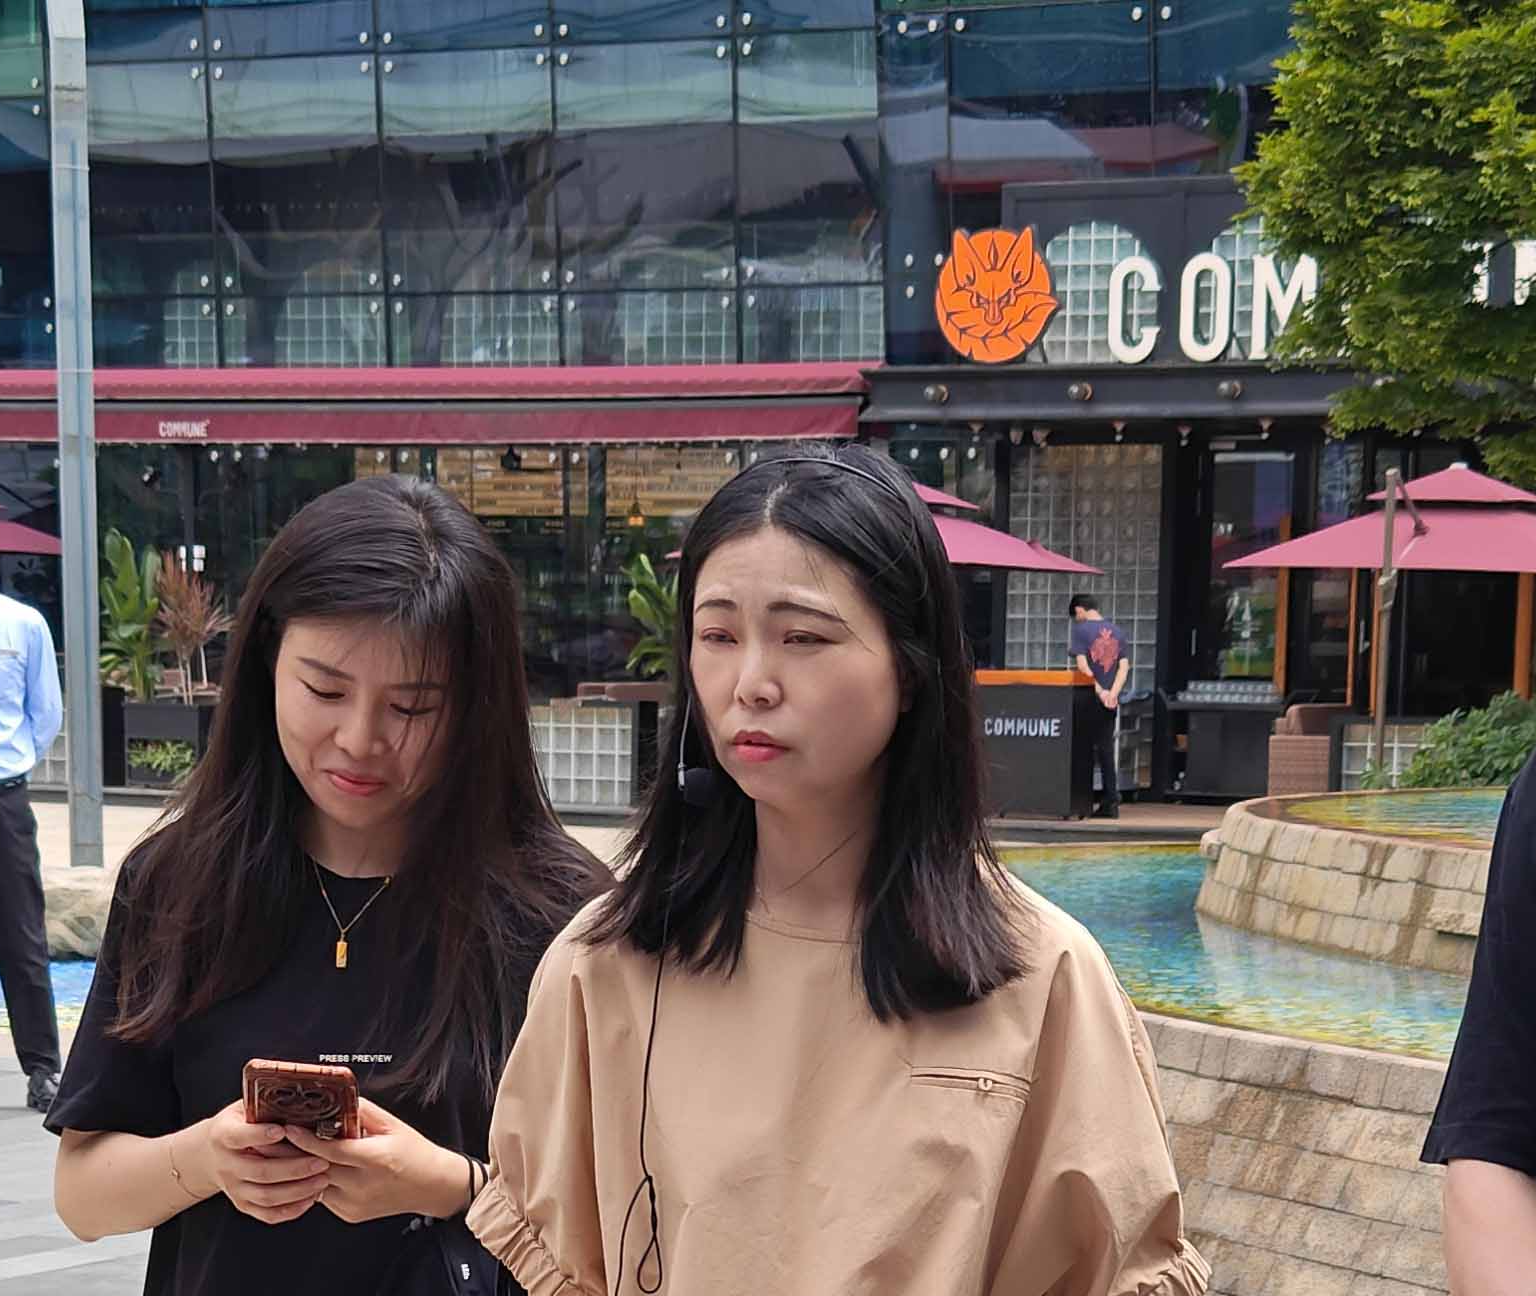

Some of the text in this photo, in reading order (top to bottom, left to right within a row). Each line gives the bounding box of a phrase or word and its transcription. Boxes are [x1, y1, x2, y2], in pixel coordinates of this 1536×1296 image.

[984, 717, 1062, 737] COMMUNE
[319, 1054, 393, 1063] PRESS PREVIEW
